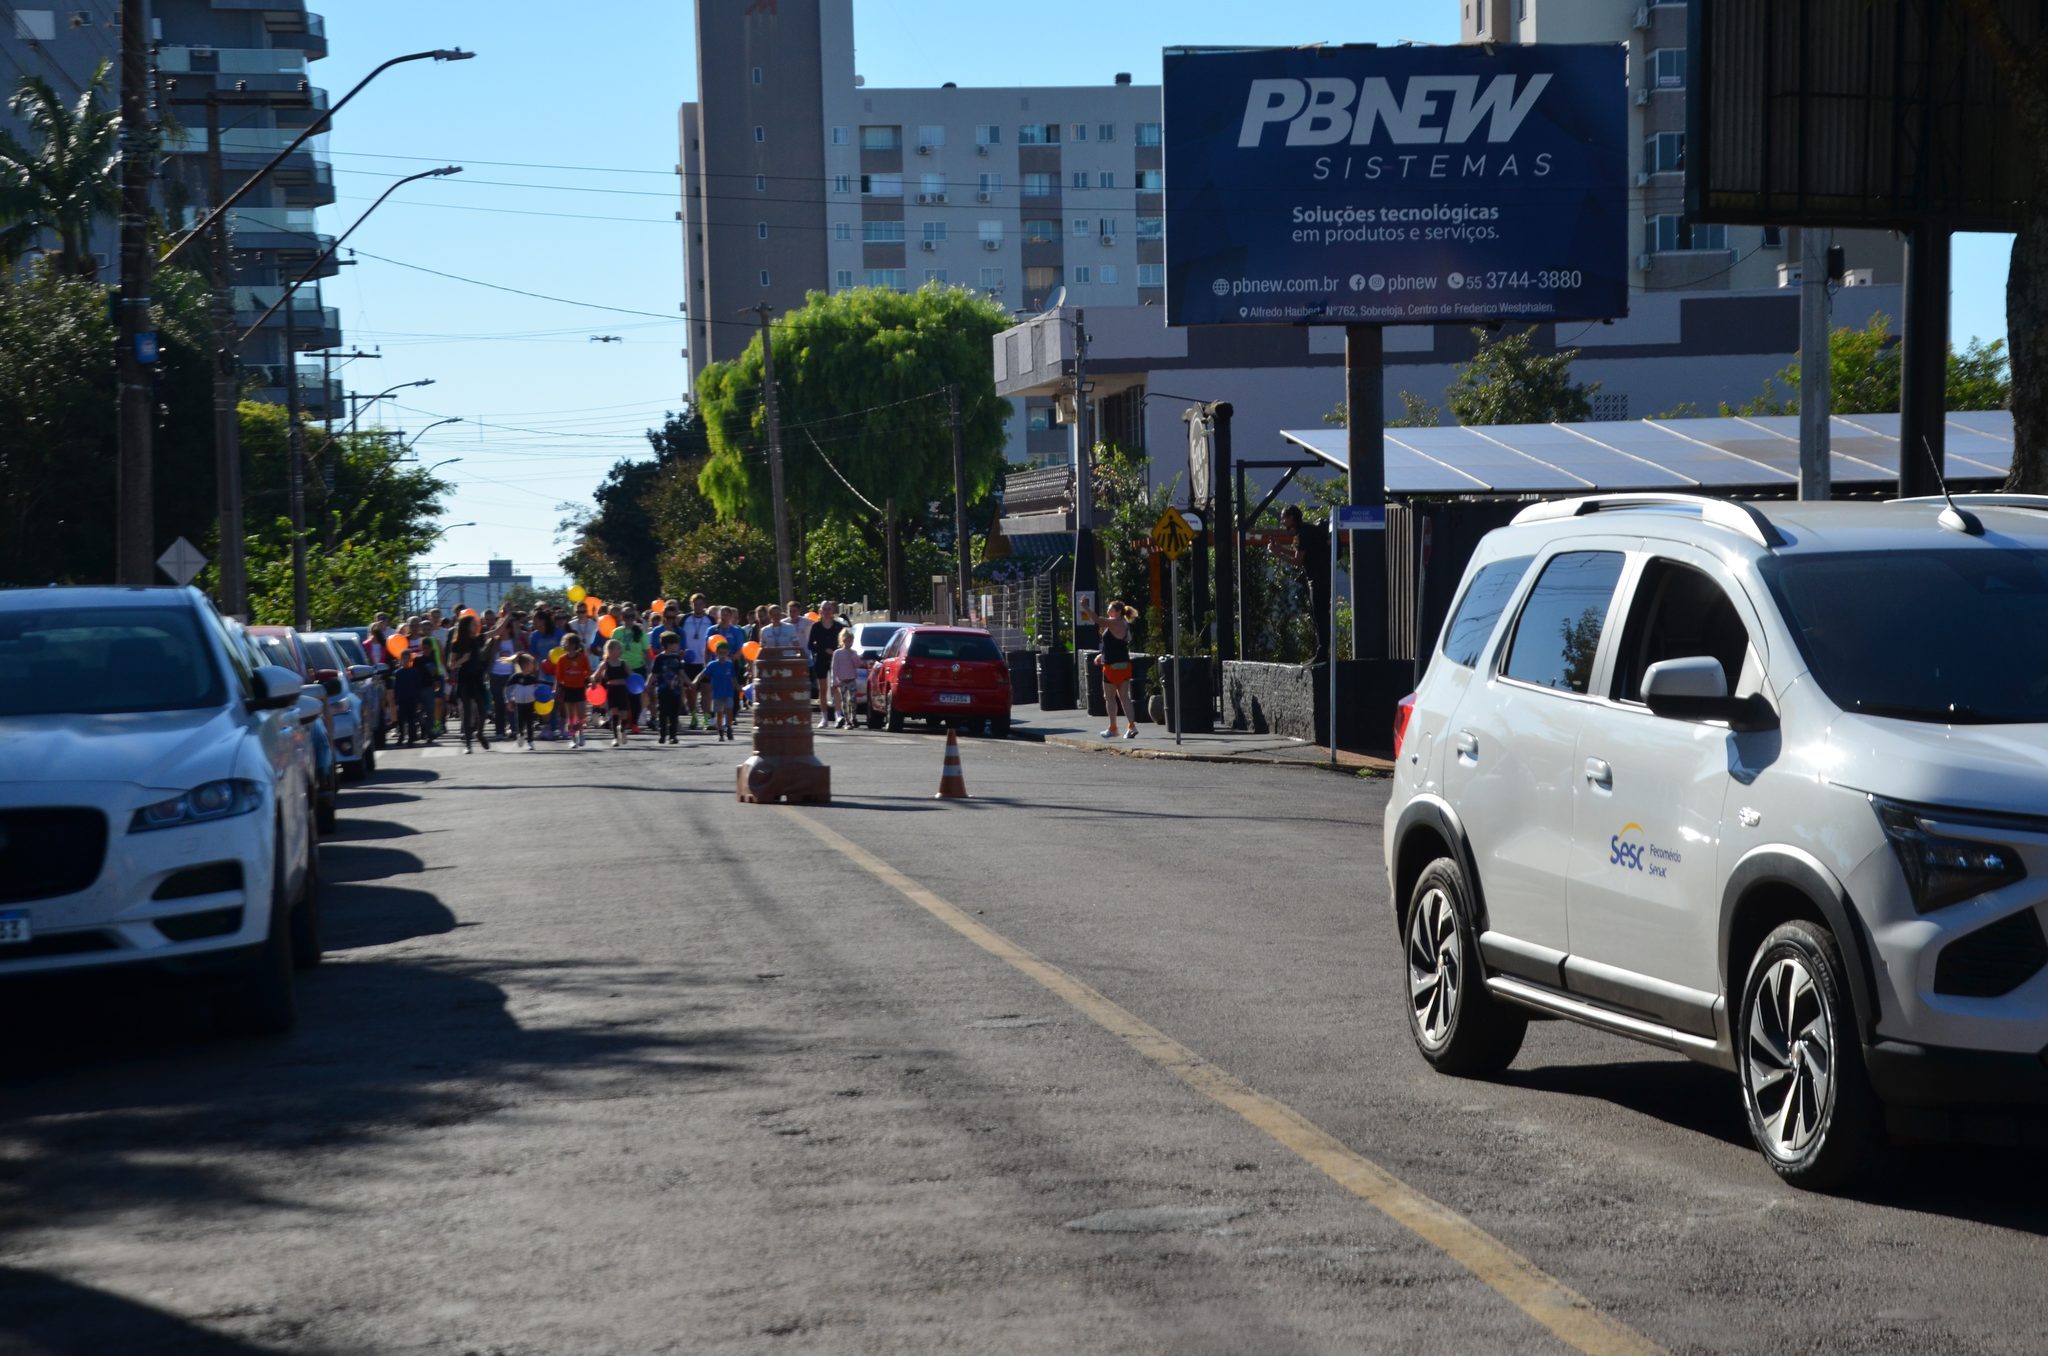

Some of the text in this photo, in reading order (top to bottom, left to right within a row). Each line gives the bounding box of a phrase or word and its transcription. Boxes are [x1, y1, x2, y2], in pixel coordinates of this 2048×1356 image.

[1237, 73, 1554, 147] PBNEW
[1313, 153, 1552, 180] SISTEMAS
[1292, 203, 1499, 226] Soluções tecnológicas
[1292, 223, 1500, 245] em produtos e serviços.
[1233, 270, 1582, 296] pbnew.com.br pbnew 55 3744-3880
[1250, 306, 1282, 318] Alfredo
[1408, 303, 1438, 315] Centro
[1440, 303, 1452, 314] de
[1454, 302, 1498, 314] Frederico
[1610, 834, 1644, 871] Sesc
